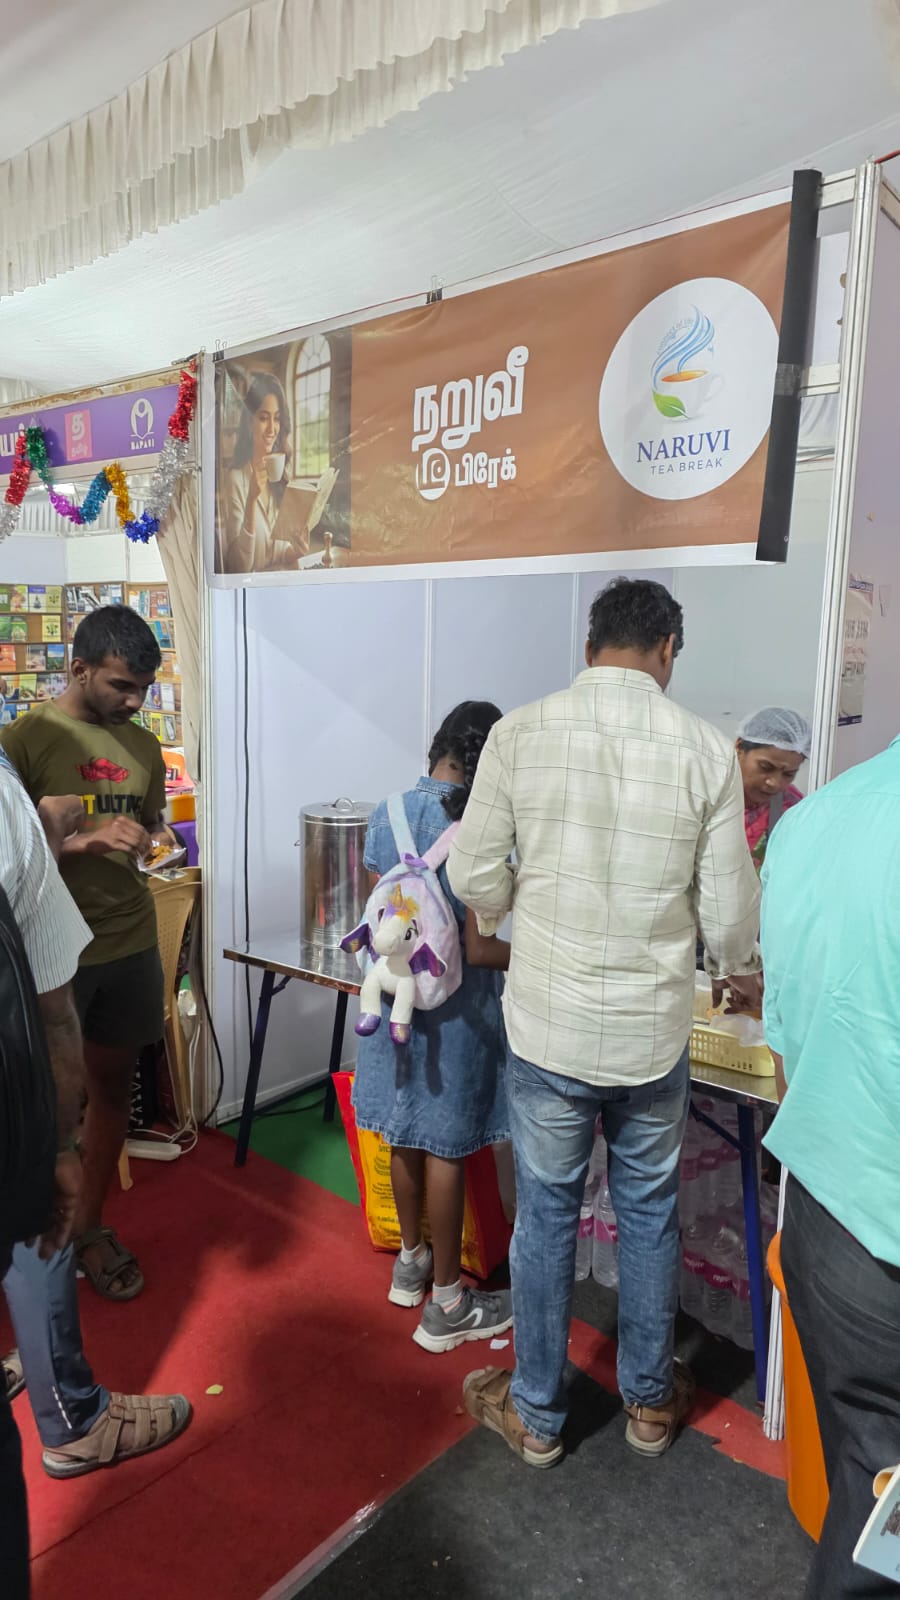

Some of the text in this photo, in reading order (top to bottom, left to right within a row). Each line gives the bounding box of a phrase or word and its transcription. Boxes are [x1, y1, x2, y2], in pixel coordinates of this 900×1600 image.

[412, 345, 529, 452] நறுவீ
[637, 429, 730, 463] NARUVI
[455, 448, 517, 488] பிரேக்
[651, 457, 723, 475] TEA BREAK
